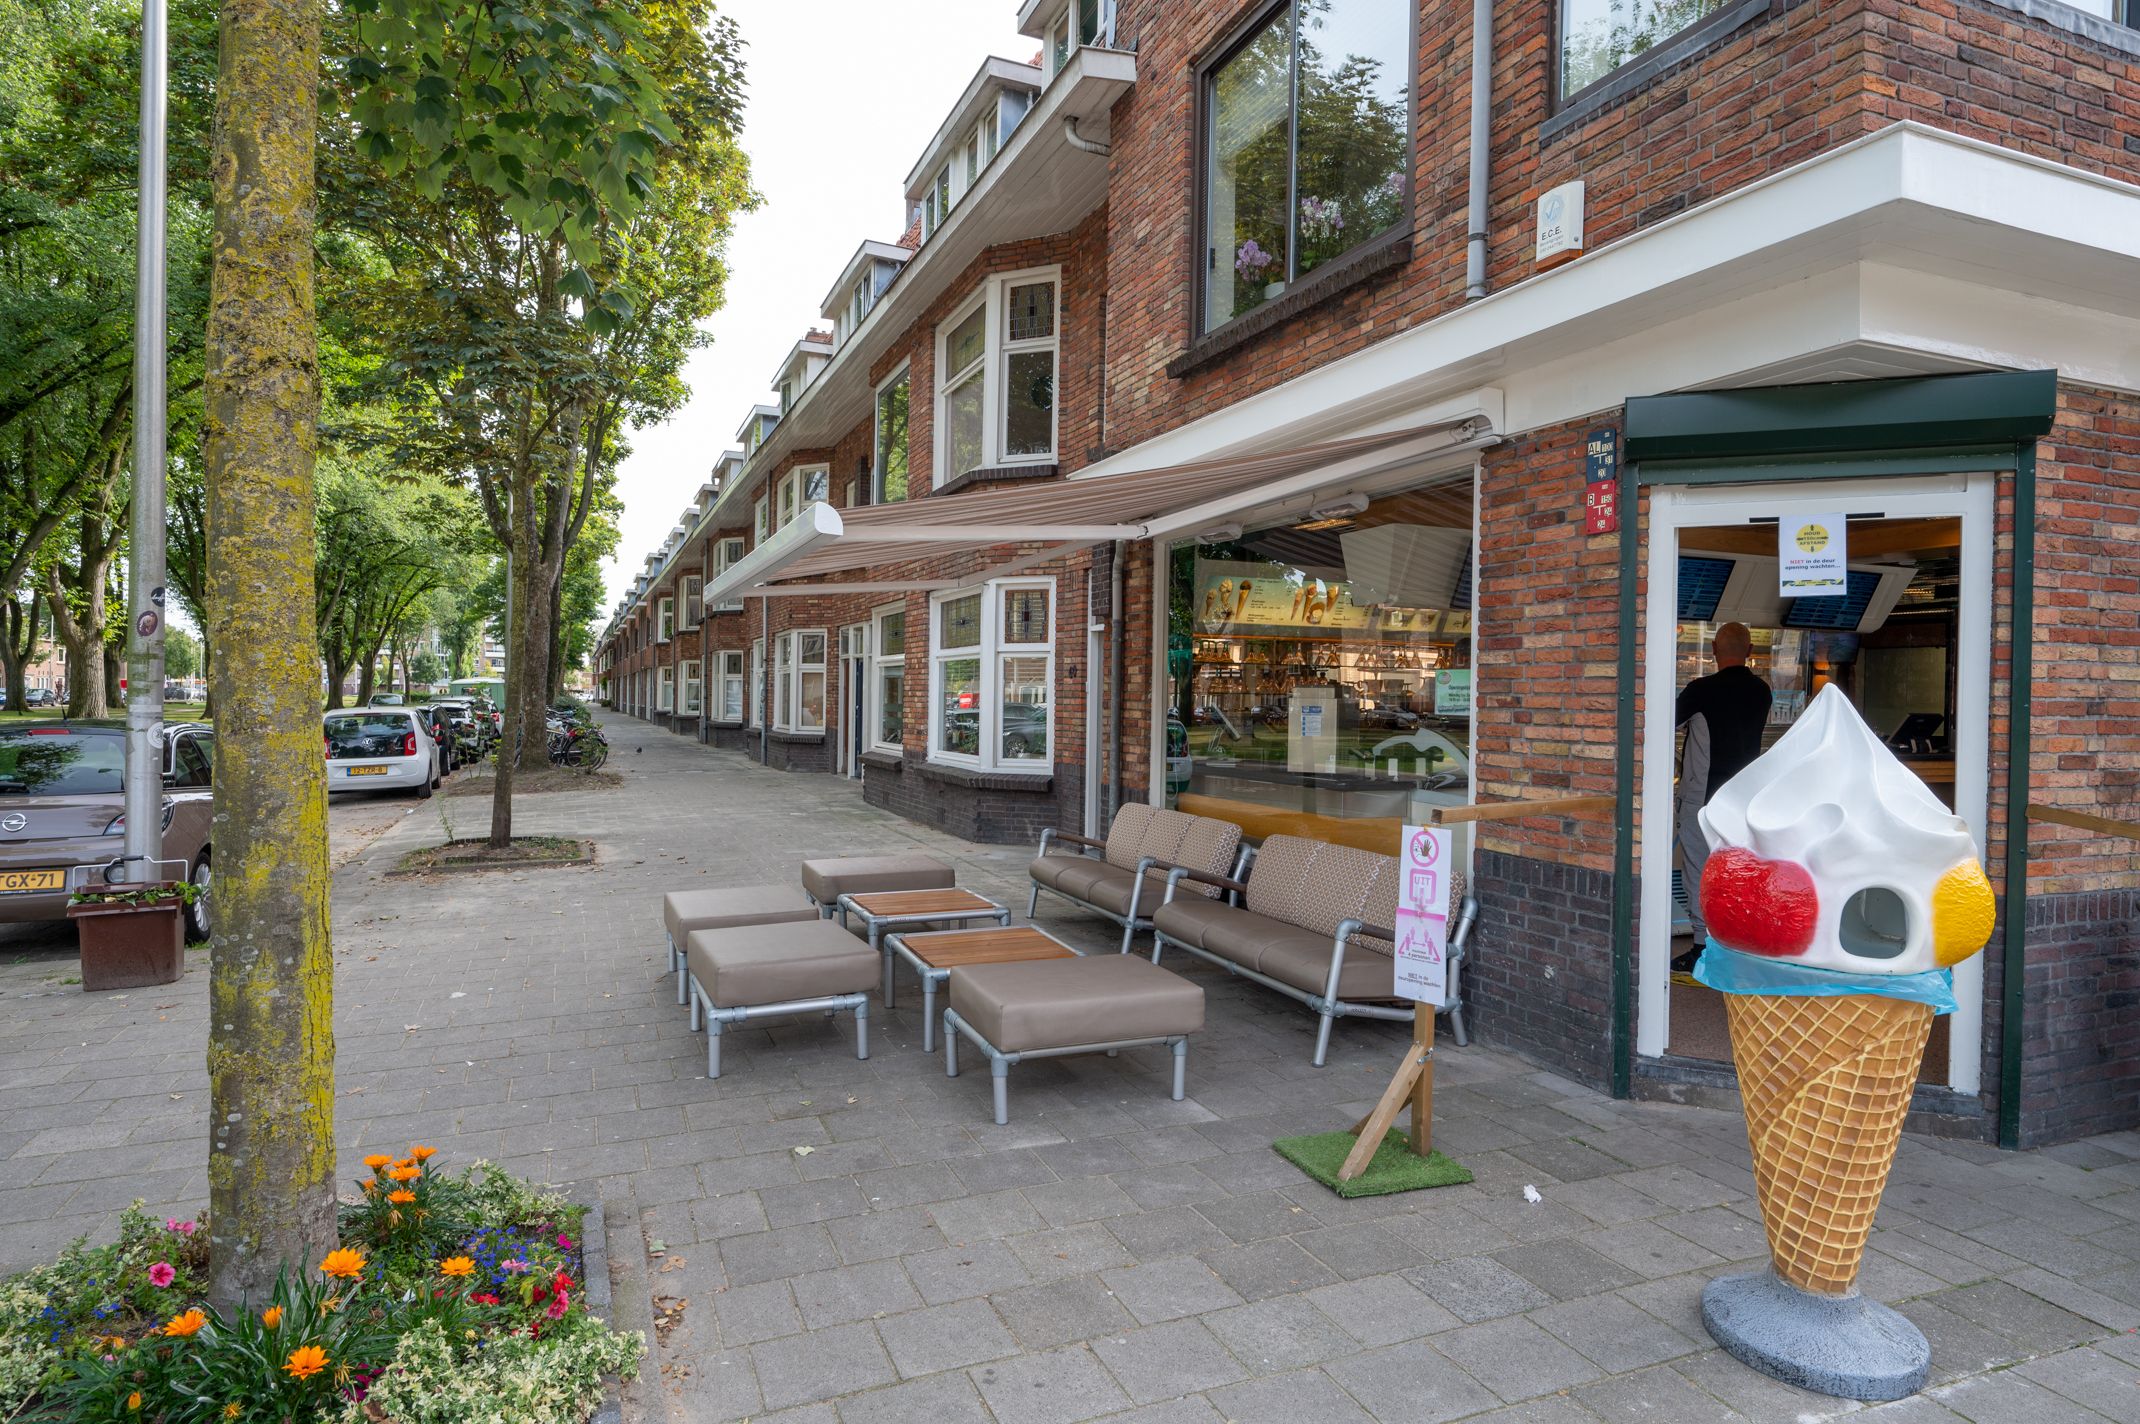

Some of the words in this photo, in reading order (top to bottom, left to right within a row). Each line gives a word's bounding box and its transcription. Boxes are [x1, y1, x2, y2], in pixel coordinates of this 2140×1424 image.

[1589, 442, 1600, 454] AL
[1589, 494, 1594, 505] B
[1414, 875, 1432, 886] UIT
